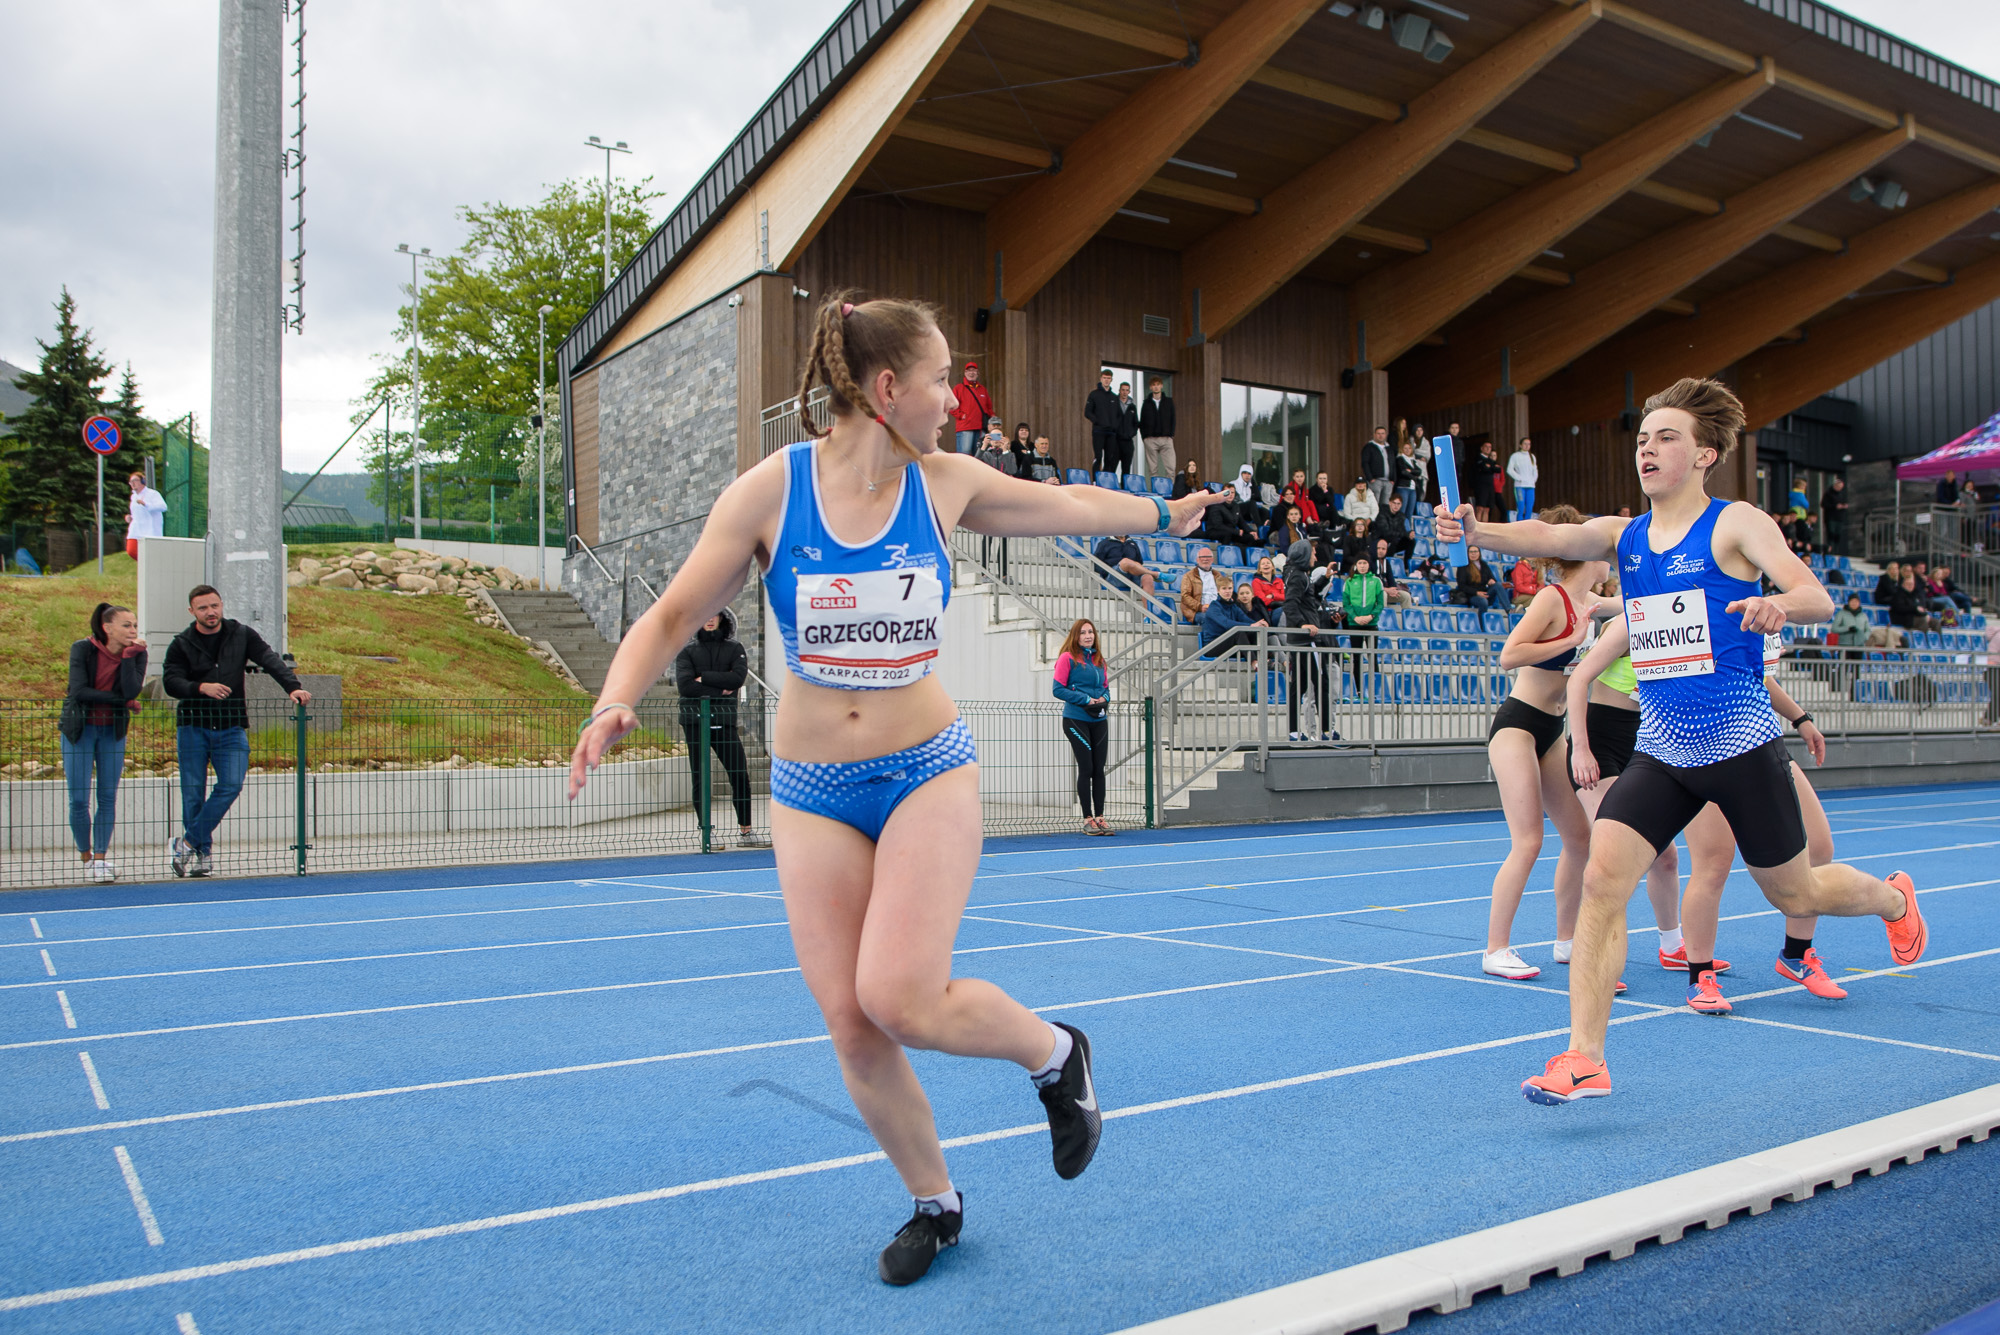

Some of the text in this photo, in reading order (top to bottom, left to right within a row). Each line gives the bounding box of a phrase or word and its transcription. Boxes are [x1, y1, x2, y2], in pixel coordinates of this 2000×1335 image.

[791, 545, 822, 561] esa
[899, 573, 915, 601] 7
[812, 598, 854, 608] ORLEN
[1672, 595, 1685, 614] 6
[805, 616, 937, 645] GRZEGORZEK
[819, 666, 910, 680] KARPACZ 2022
[1667, 664, 1688, 673] 2022
